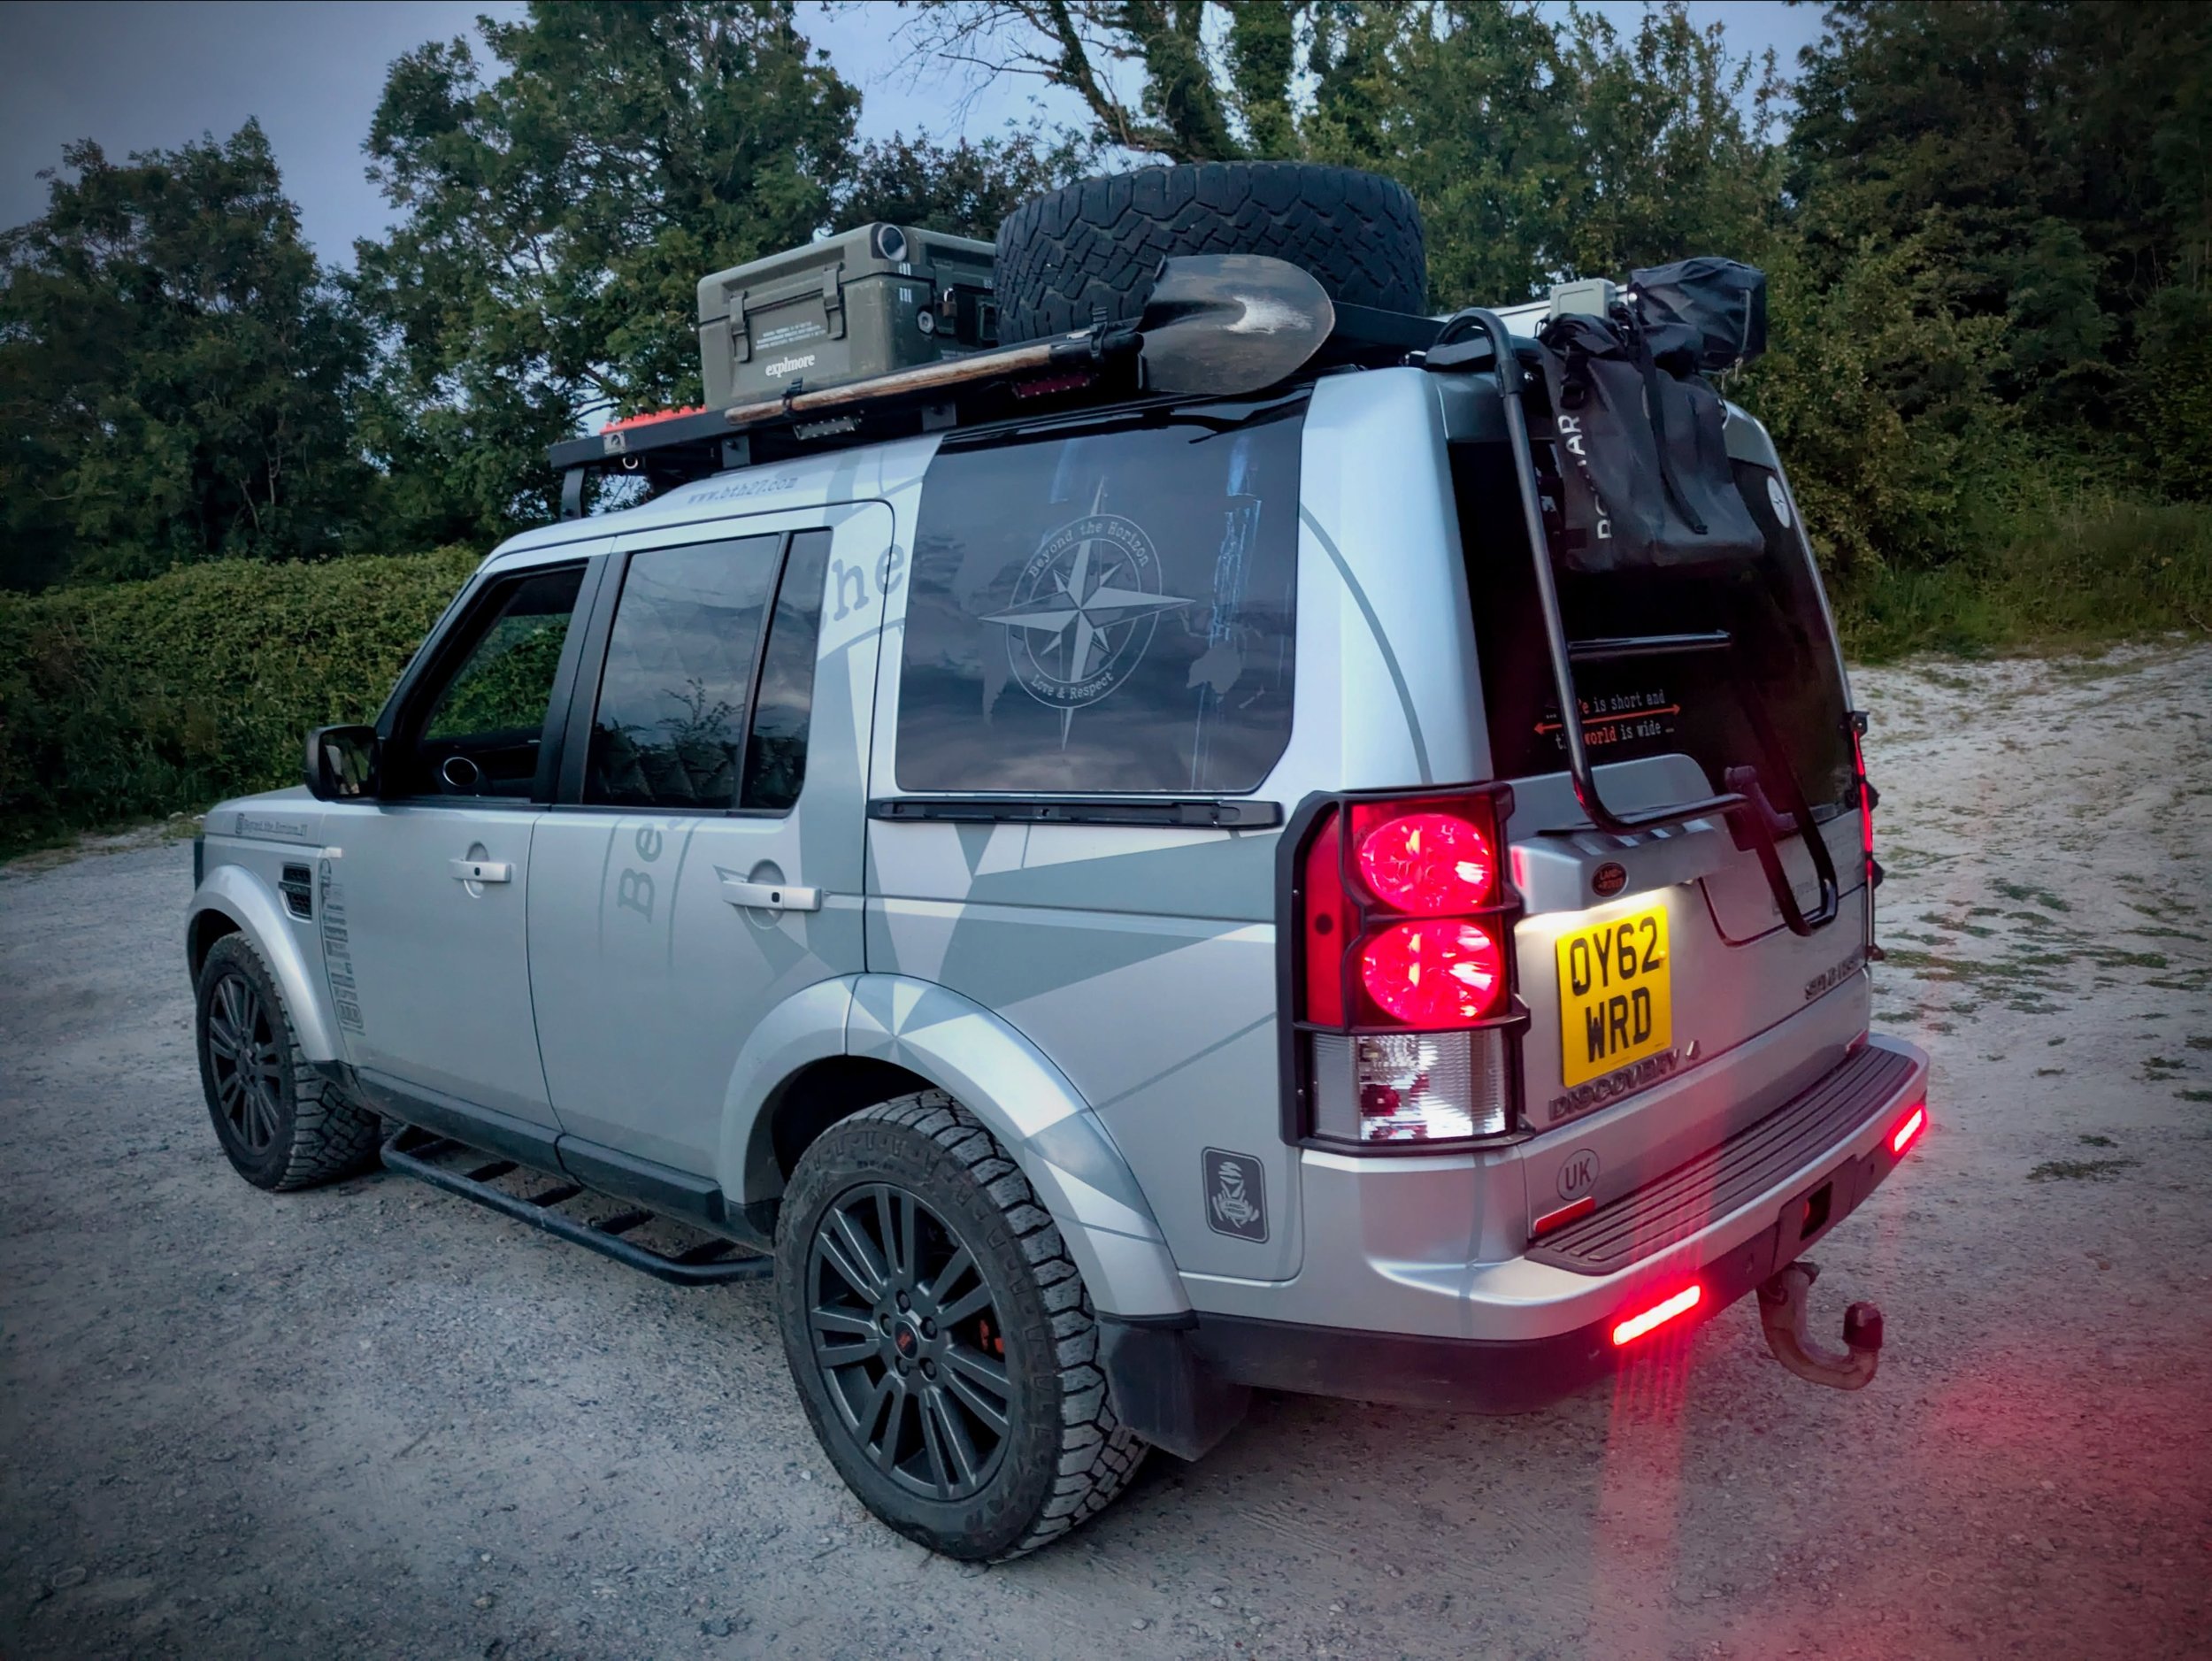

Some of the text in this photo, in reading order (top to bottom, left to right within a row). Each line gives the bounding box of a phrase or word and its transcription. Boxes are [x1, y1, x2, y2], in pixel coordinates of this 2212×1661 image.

[764, 355, 815, 378] explmore
[1028, 520, 1149, 577] Beyond the Horizon
[819, 543, 905, 621] he
[1030, 673, 1055, 696] Love
[1069, 672, 1114, 700] Respect
[1594, 696, 1607, 712] is
[1610, 693, 1642, 711] short
[1646, 689, 1665, 704] and
[1584, 726, 1618, 746] world
[1619, 724, 1633, 741] is
[1636, 720, 1662, 737] wide
[1570, 916, 1660, 996] OY62
[1586, 987, 1652, 1063] WRD
[1565, 1157, 1591, 1190] UK
